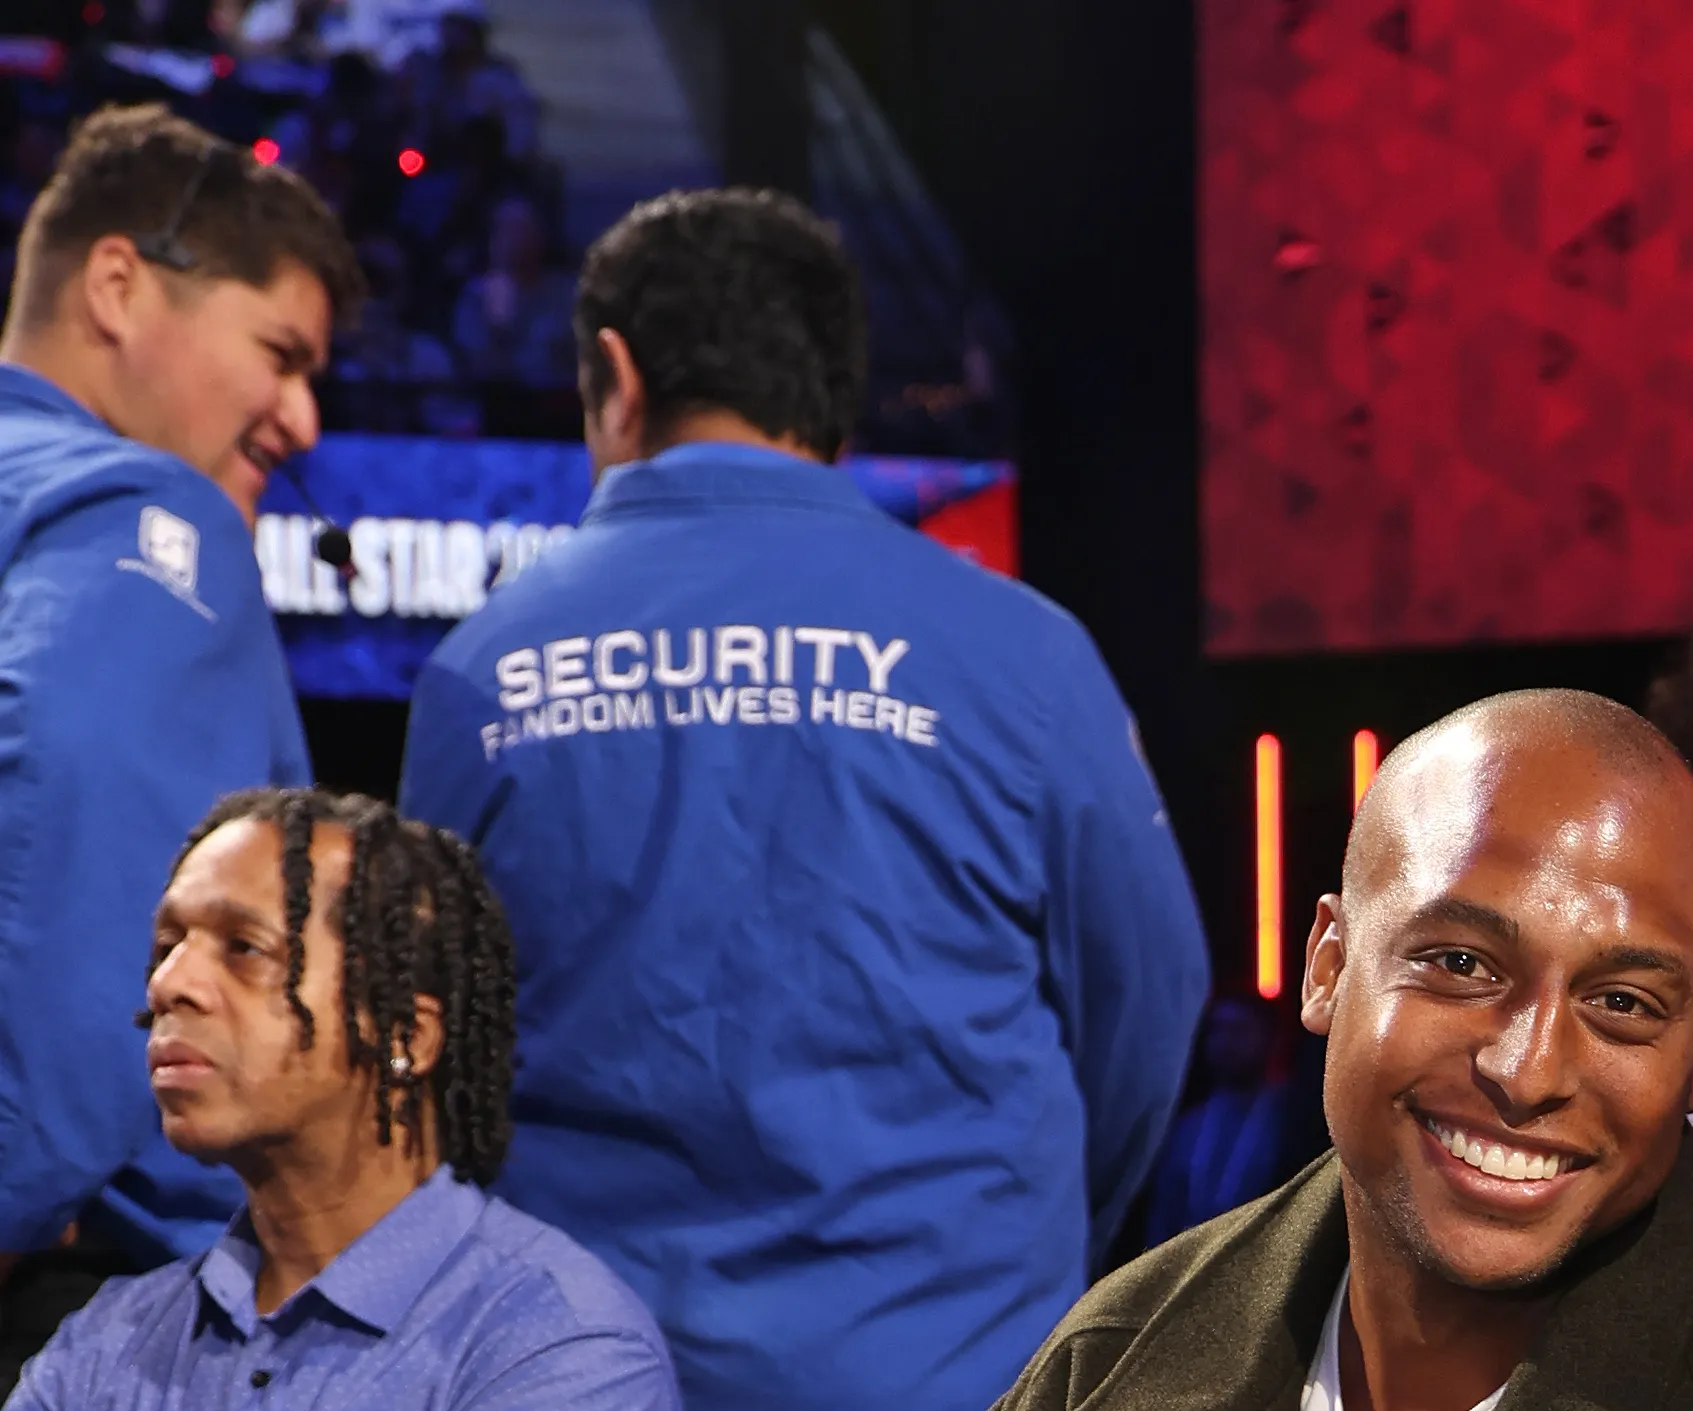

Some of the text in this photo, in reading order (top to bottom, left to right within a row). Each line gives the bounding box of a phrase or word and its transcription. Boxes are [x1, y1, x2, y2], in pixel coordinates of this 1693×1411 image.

[349, 515, 488, 619] STAR
[495, 625, 910, 712] SECURITY
[666, 686, 800, 726] LIVES
[810, 687, 941, 748] HERE
